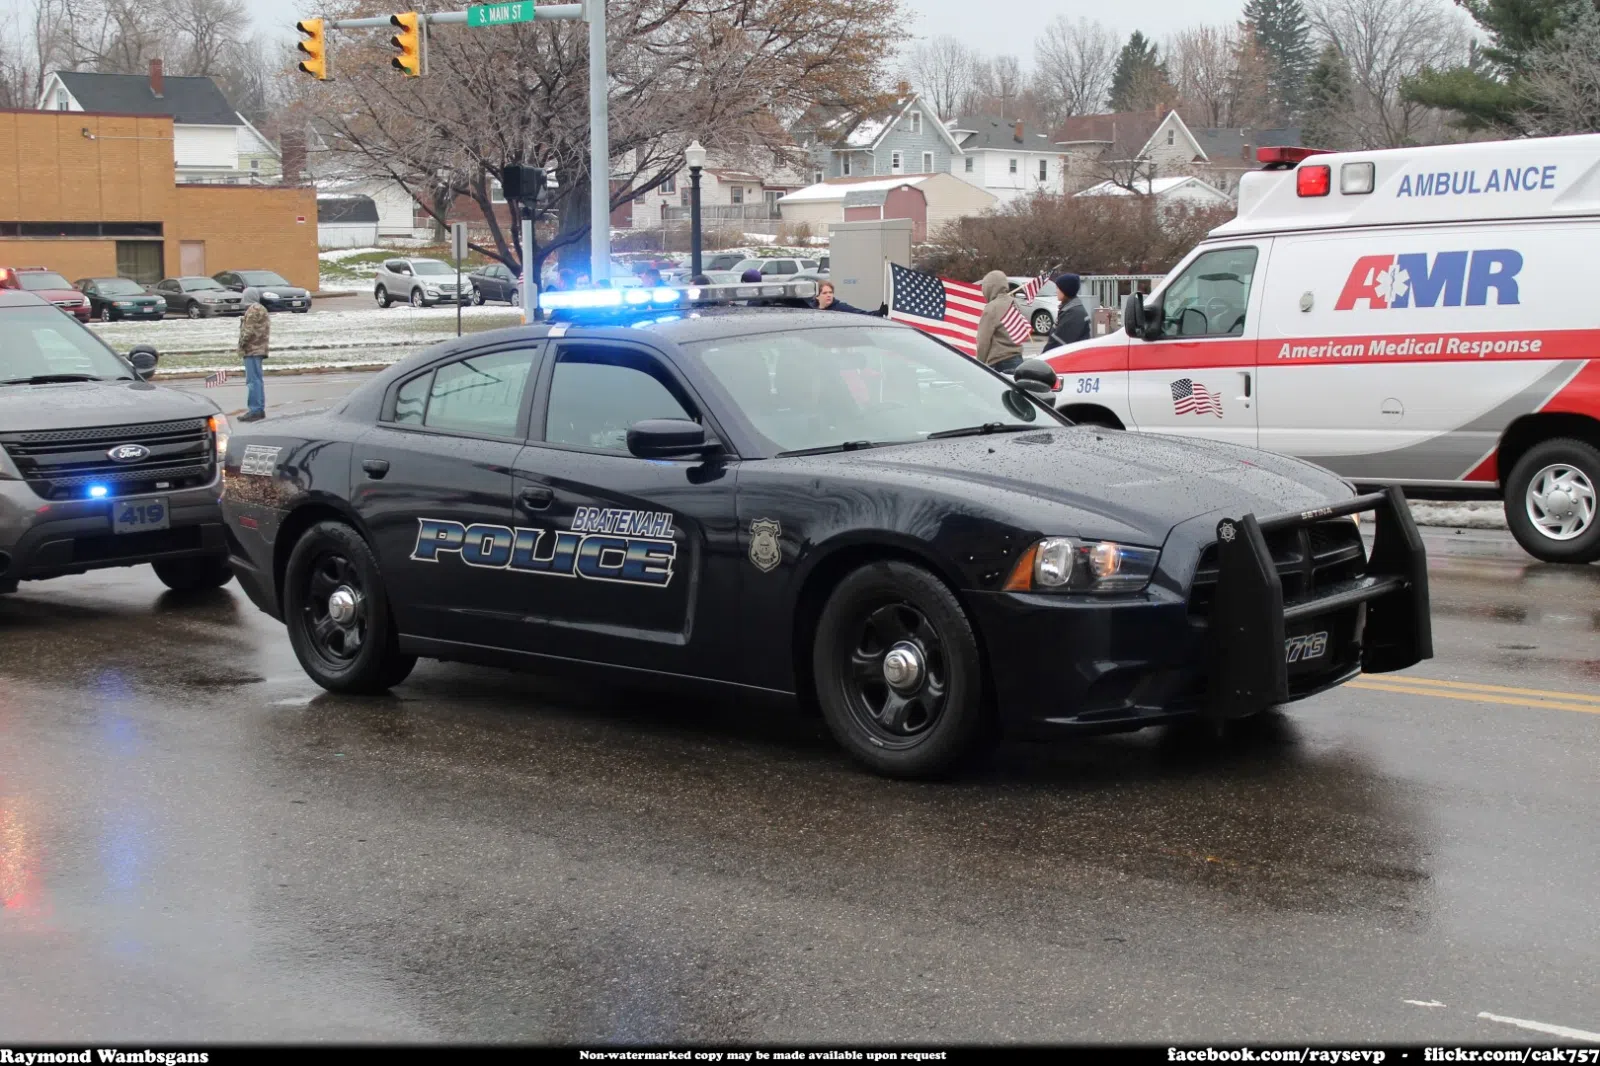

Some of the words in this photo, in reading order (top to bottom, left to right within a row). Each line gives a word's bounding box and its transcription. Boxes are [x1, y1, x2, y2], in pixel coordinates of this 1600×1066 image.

[480, 8, 487, 23] S.
[489, 6, 509, 22] MAIN
[512, 5, 522, 20] ST
[1397, 165, 1557, 198] AMBULANCE
[1334, 248, 1524, 311] AMR
[1278, 341, 1364, 359] American
[1368, 337, 1443, 356] Medical
[1446, 337, 1542, 358] Response
[1076, 377, 1100, 394] 364
[118, 447, 142, 459] Ford
[120, 504, 164, 525] 419
[571, 506, 676, 539] BRATENAHL
[1301, 507, 1332, 519] SETINA
[410, 517, 677, 588] POLICE
